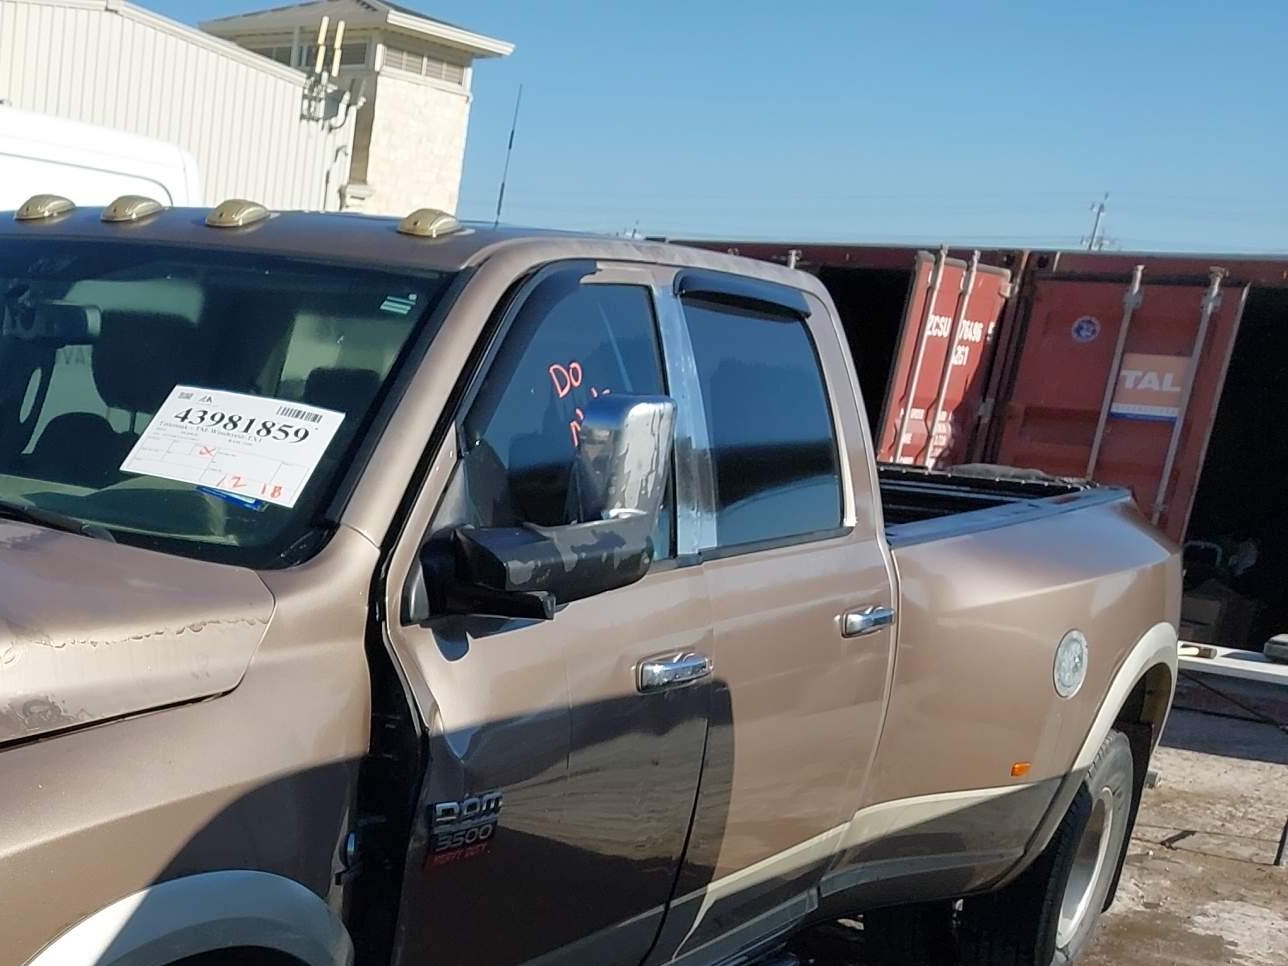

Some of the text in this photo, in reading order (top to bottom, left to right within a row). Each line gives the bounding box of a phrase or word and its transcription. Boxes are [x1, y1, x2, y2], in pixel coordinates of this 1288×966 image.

[548, 360, 583, 399] DO
[1121, 369, 1181, 392] TAL
[174, 407, 310, 443] 43981859
[436, 824, 493, 852] 3500
